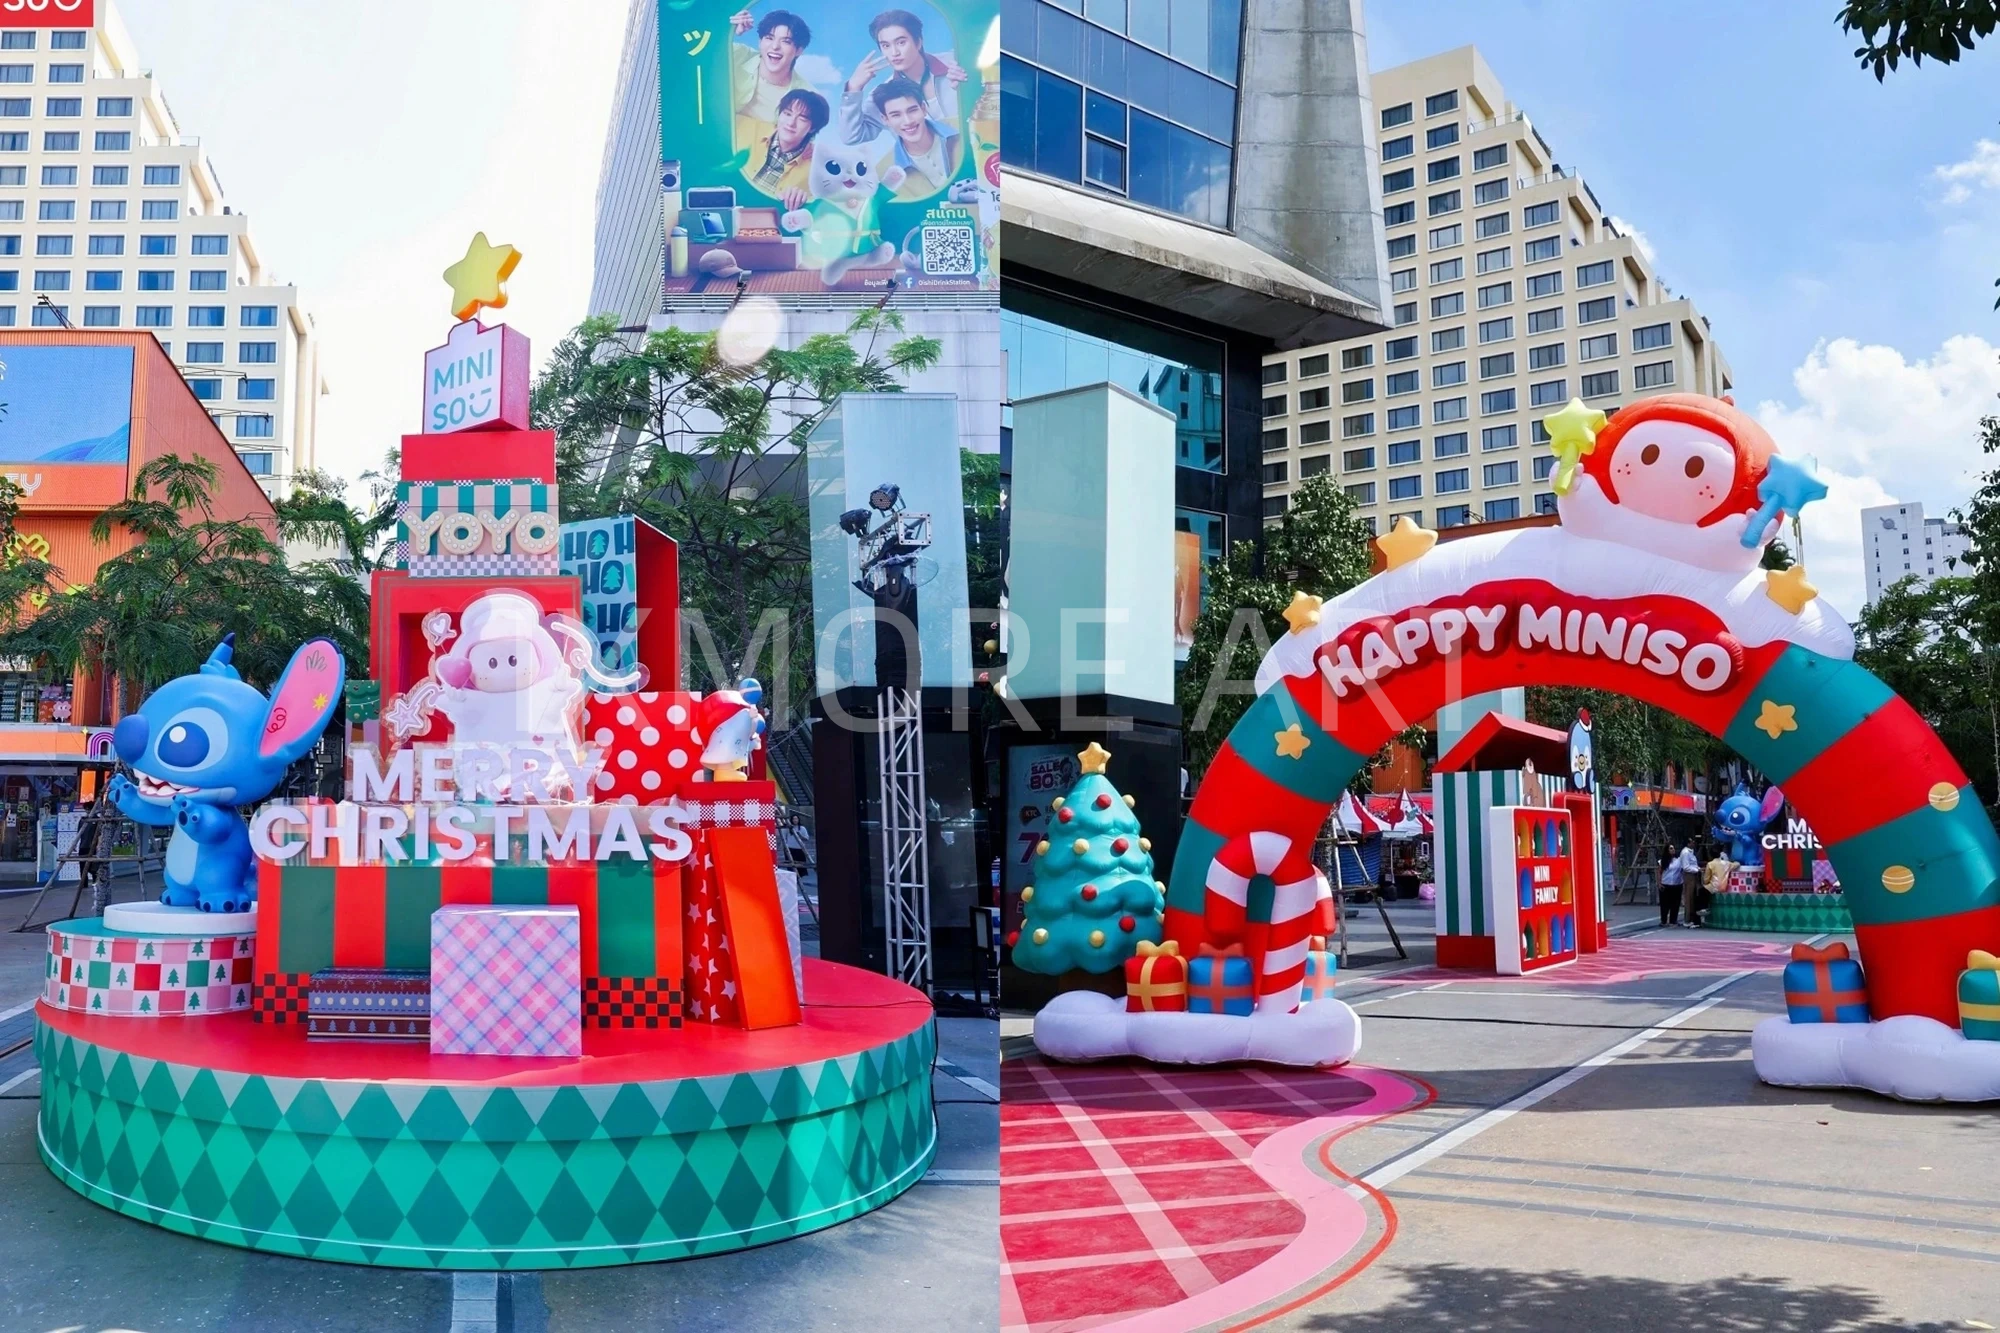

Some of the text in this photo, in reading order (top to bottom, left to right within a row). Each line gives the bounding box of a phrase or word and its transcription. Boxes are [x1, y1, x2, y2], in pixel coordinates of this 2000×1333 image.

[926, 208, 967, 218] สแกน
[433, 349, 493, 395] MINI
[403, 509, 559, 555] YOYO
[1318, 604, 1732, 697] HAPPY MINISO
[352, 748, 605, 802] MERRY
[248, 805, 694, 863] CHRISTMAS
[1788, 818, 1813, 834] M
[1533, 865, 1551, 883] MINI
[1534, 886, 1559, 905] FAMILY
